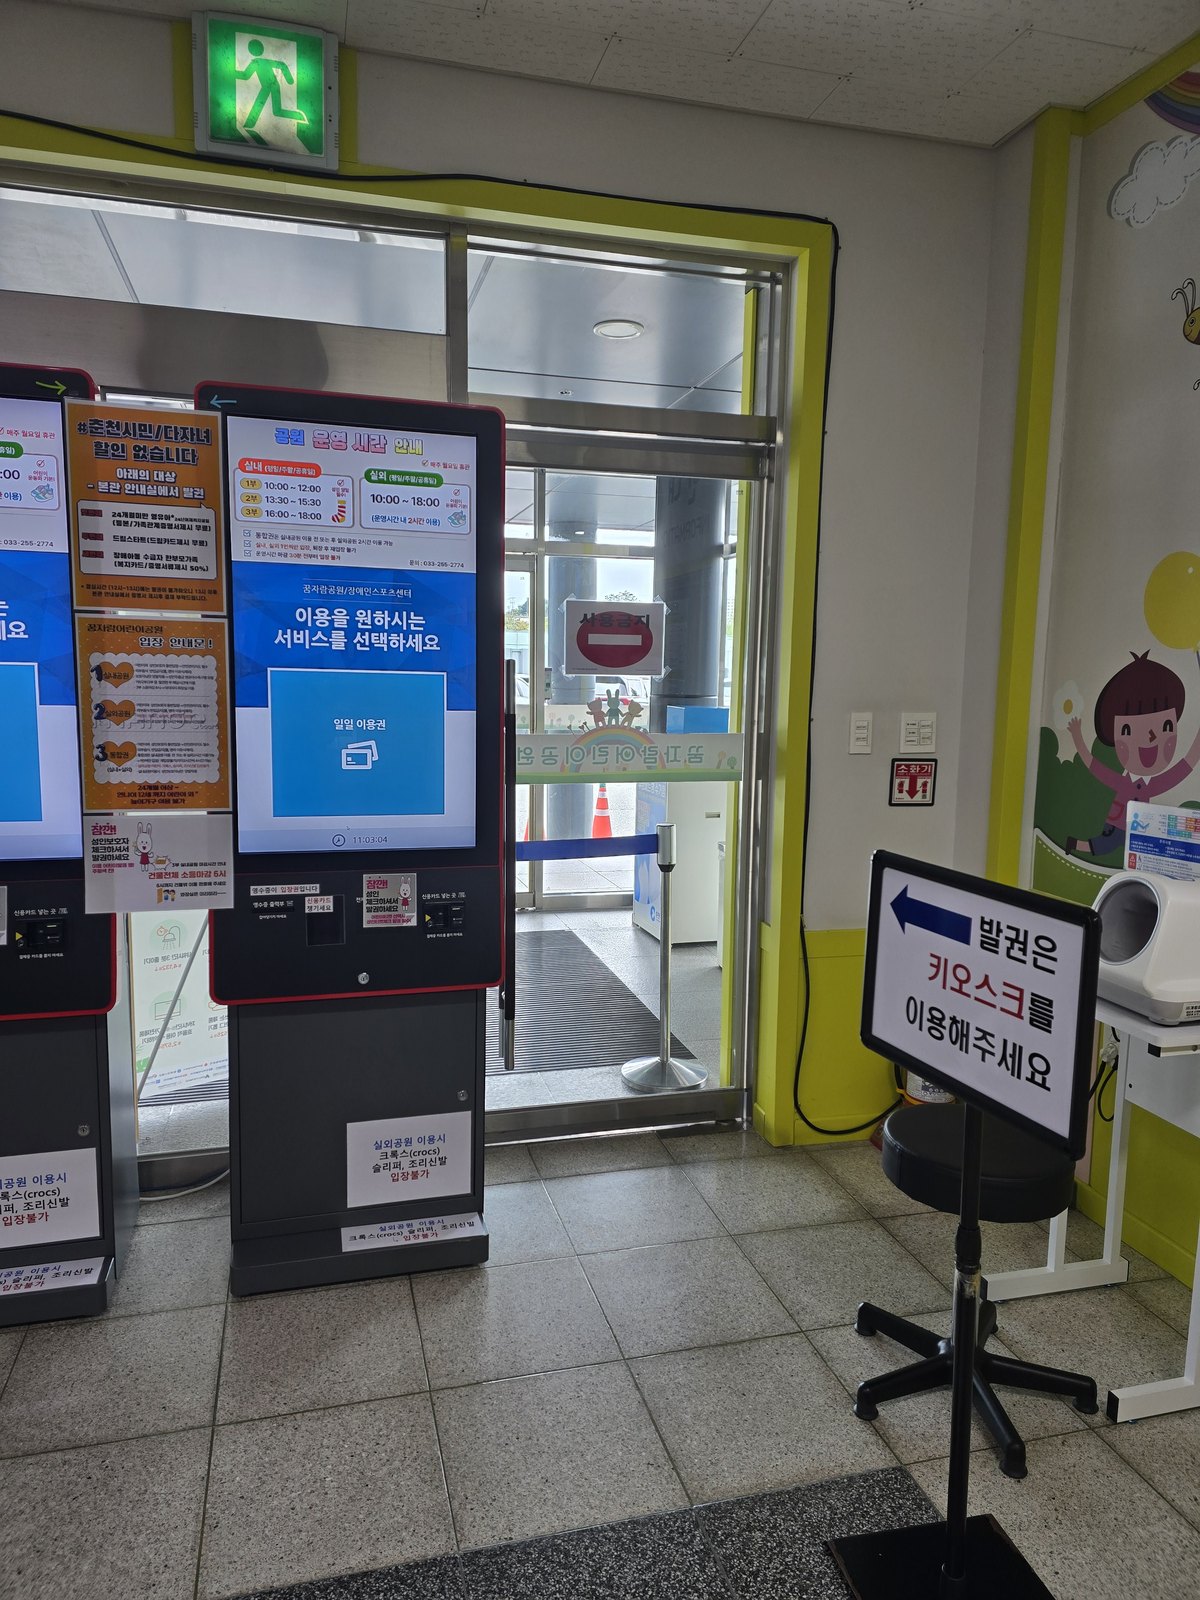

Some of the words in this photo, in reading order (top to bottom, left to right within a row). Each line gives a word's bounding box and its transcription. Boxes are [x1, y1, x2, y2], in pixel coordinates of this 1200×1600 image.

[7, 429, 20, 437] 매주
[22, 430, 41, 438] 월요일
[43, 431, 55, 439] 휴관
[77, 418, 212, 445] #춘천시민/다자녀
[275, 427, 305, 446] 공원
[312, 429, 347, 451] 운영
[352, 432, 387, 454] 시간
[394, 438, 423, 455] 안내
[93, 441, 127, 460] 할인
[132, 444, 198, 464] 없습니다
[244, 461, 262, 472] 실내
[116, 468, 150, 481] 아래의
[153, 470, 177, 482] 대상
[370, 470, 387, 481] 실외
[98, 481, 121, 493] 본관
[125, 483, 179, 498] 안내실에서
[183, 487, 205, 499] 발권
[264, 482, 289, 491] 10:00
[298, 484, 321, 493] 12:00
[265, 495, 289, 505] 13:30
[298, 498, 321, 507] 15:30
[370, 493, 400, 504] 10:00
[411, 497, 440, 507] 18:00
[112, 511, 149, 520] 24개월미만
[246, 508, 258, 516] 3부
[265, 509, 289, 518] 16:00
[298, 512, 322, 520] 18:00
[371, 514, 399, 524] (운영시간
[400, 517, 407, 525] 내
[408, 517, 425, 526] 2시간
[426, 518, 440, 527] 이용)
[3, 539, 54, 547] 033-255-2774
[143, 553, 163, 561] 수급자
[303, 584, 412, 598] 꿈자람공원/장애인스포츠센터
[295, 606, 350, 628] 이용을
[355, 609, 426, 631] 원하시는
[579, 612, 650, 629] 사용금지
[87, 623, 164, 634] 꿈자람어린이공원
[139, 636, 164, 648] 입장
[169, 637, 206, 649] 안내문
[274, 629, 348, 650] 서비스를
[353, 632, 441, 653] 선택하세요
[103, 671, 130, 680] 실내공원
[93, 703, 106, 720] 2
[333, 718, 354, 731] 일일
[356, 718, 386, 731] 이용권
[94, 743, 108, 762] 3
[898, 764, 931, 773] 소화기
[91, 822, 117, 836] 잠깐!
[353, 836, 388, 844] 11:03:04
[148, 871, 179, 880] 건물전체
[979, 915, 1058, 975] 발권은
[928, 953, 1054, 1034] 키오스크를
[905, 995, 1052, 1092] 이용해주세요
[373, 1137, 412, 1150] 실외공원
[417, 1133, 446, 1145] 이용시
[379, 1147, 440, 1161] 크록스(crocs)
[372, 1161, 404, 1173] 슬리퍼,
[409, 1156, 447, 1168] 조리신발
[32, 1172, 67, 1185] 이용시
[391, 1169, 429, 1182] 입장불가
[23, 1197, 70, 1211] 조리신발
[2, 1212, 49, 1226] 입장불가
[349, 1231, 403, 1241] 크록스(crocs)
[408, 1226, 437, 1234] 슬리퍼,
[441, 1221, 475, 1230] 조리신발
[379, 1223, 413, 1232] 실외공원
[403, 1232, 439, 1241] 입장불가
[12, 1274, 46, 1283] 슬리퍼,
[51, 1268, 94, 1279] 조리신발
[30, 1265, 62, 1274] 이용시
[2, 1281, 45, 1291] 입장불가
